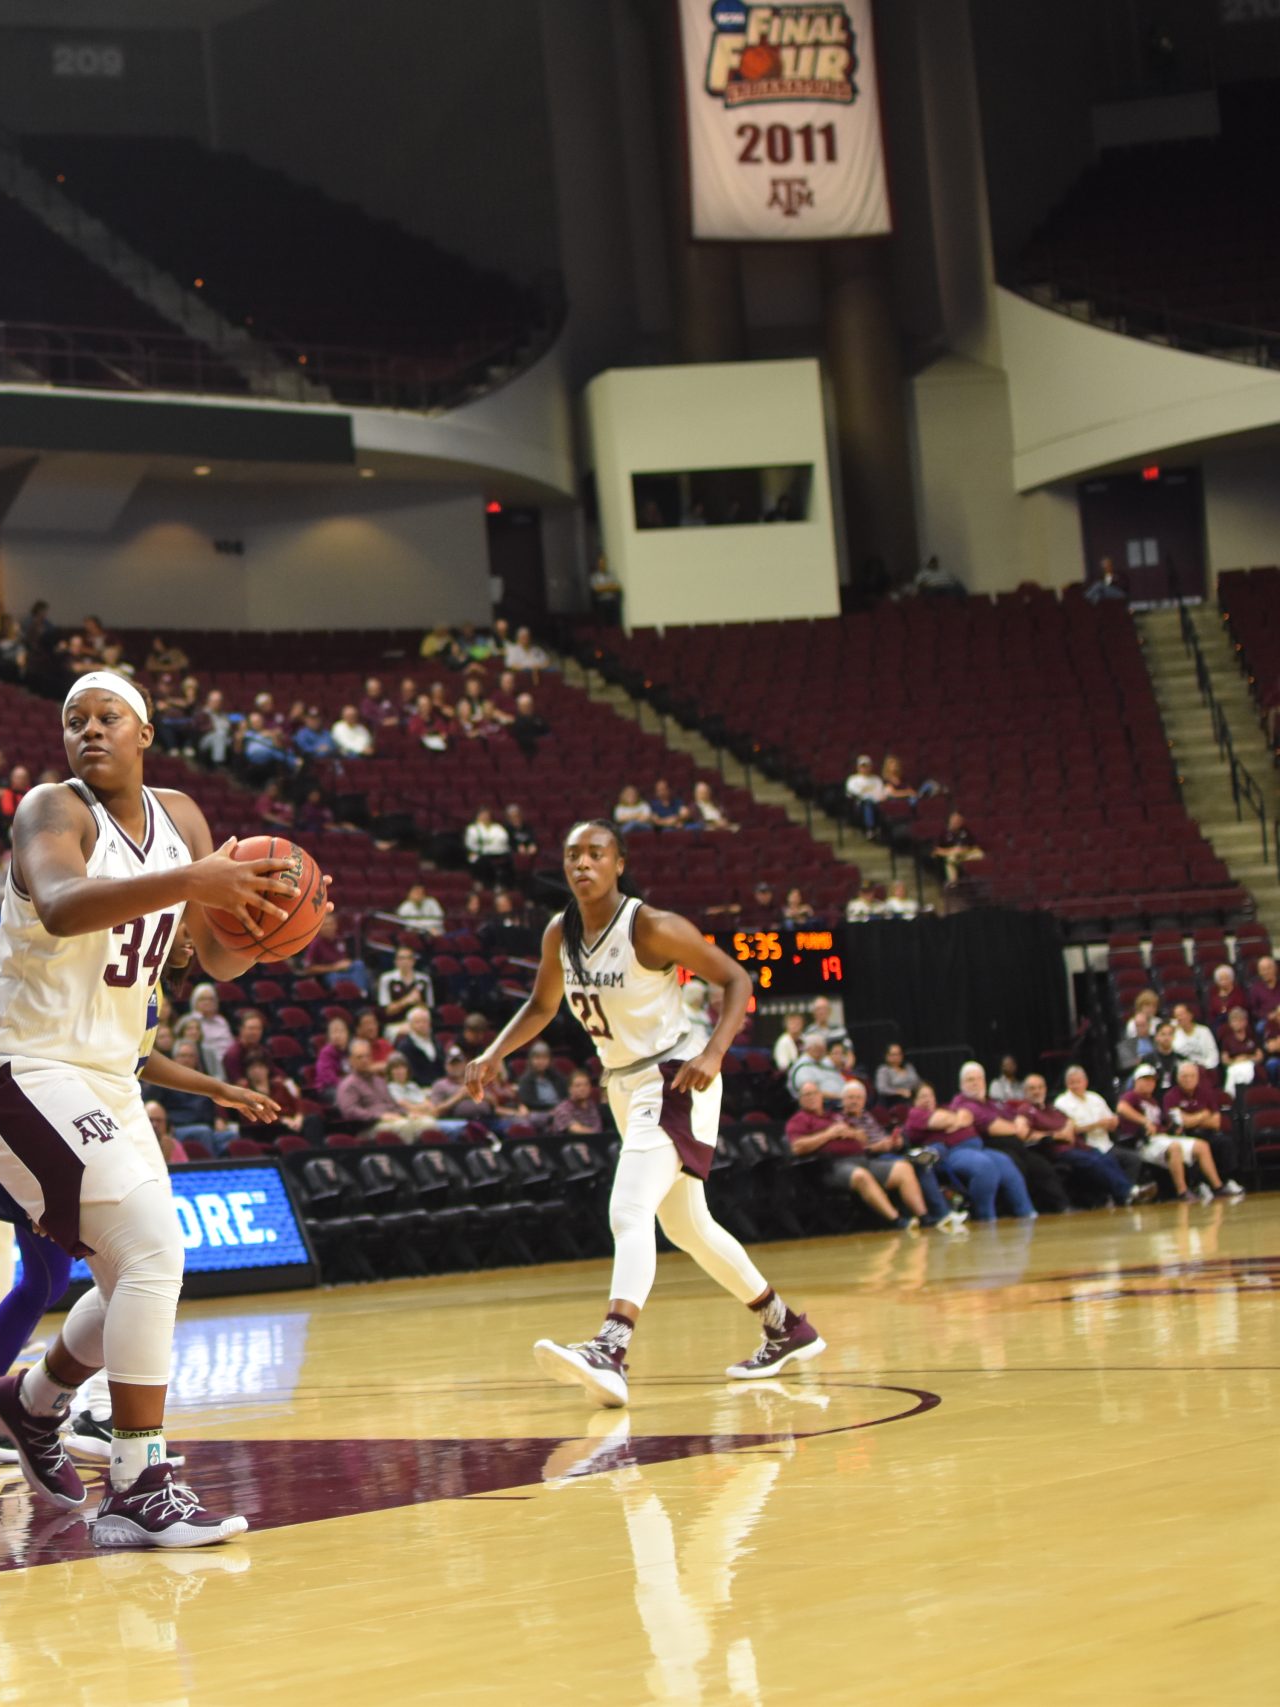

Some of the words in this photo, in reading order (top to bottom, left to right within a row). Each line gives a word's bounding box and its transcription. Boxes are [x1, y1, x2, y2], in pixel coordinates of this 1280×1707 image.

[748, 8, 848, 46] FINAL
[736, 122, 838, 165] 2011
[103, 913, 175, 988] 34
[733, 931, 783, 961] 5:35
[821, 955, 843, 981] 19
[571, 991, 614, 1040] 21
[170, 1192, 277, 1249] ORE.
